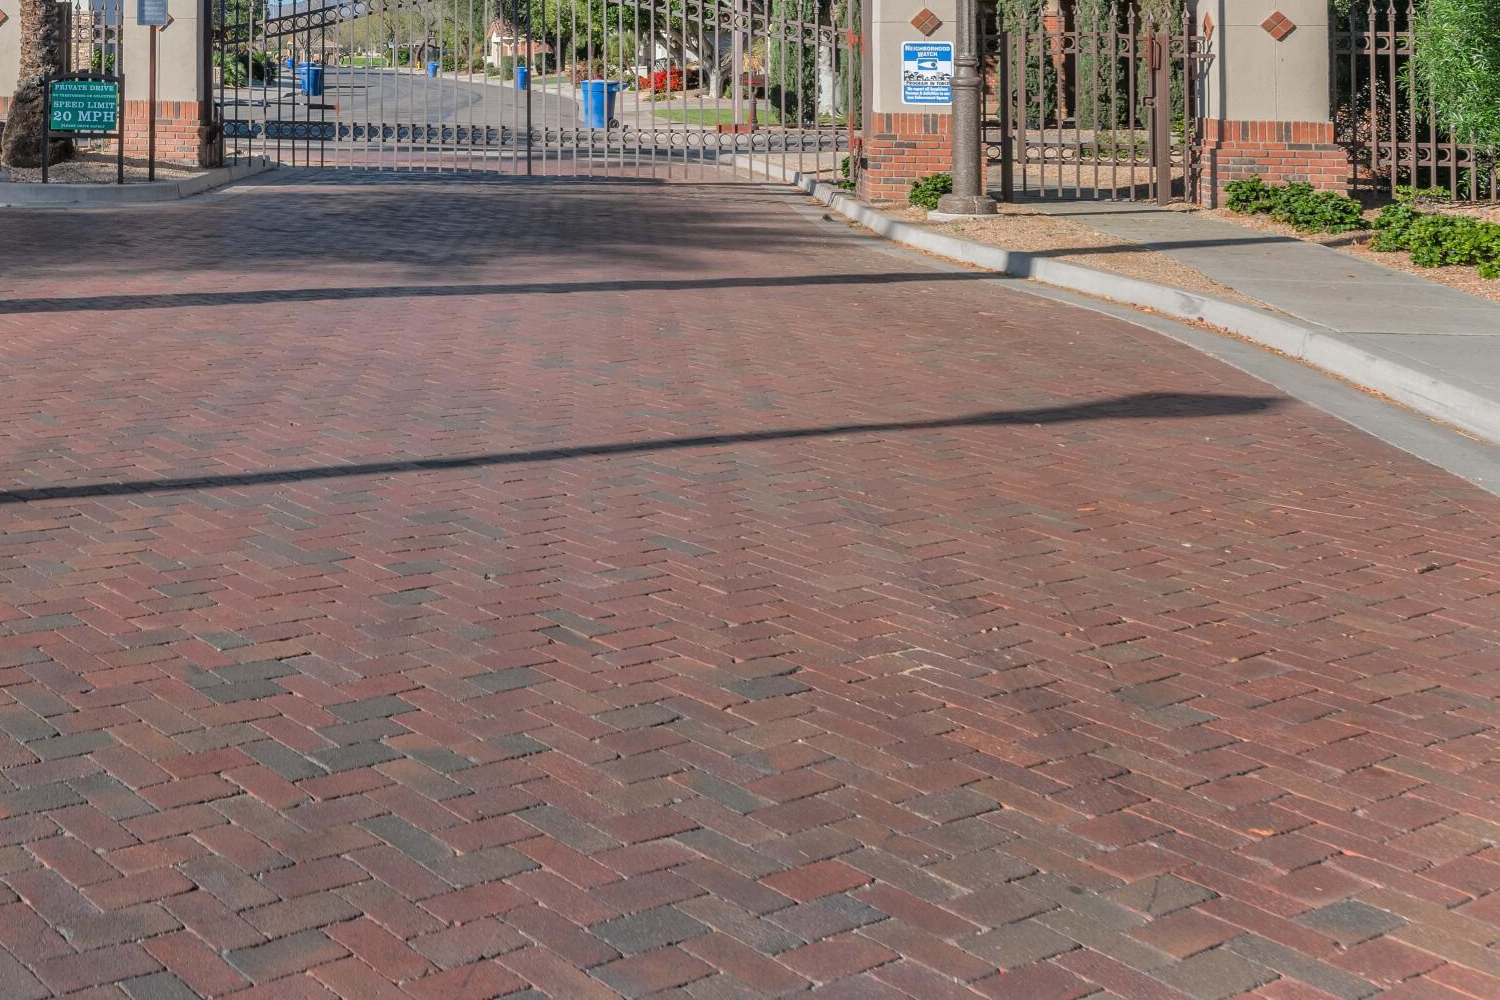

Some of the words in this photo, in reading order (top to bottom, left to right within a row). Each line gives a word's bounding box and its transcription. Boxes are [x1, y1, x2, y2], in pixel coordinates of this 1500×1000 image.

[53, 100, 84, 108] SPEED
[87, 101, 115, 109] LIMIT
[53, 110, 72, 121] 20
[78, 110, 115, 122] MPH
